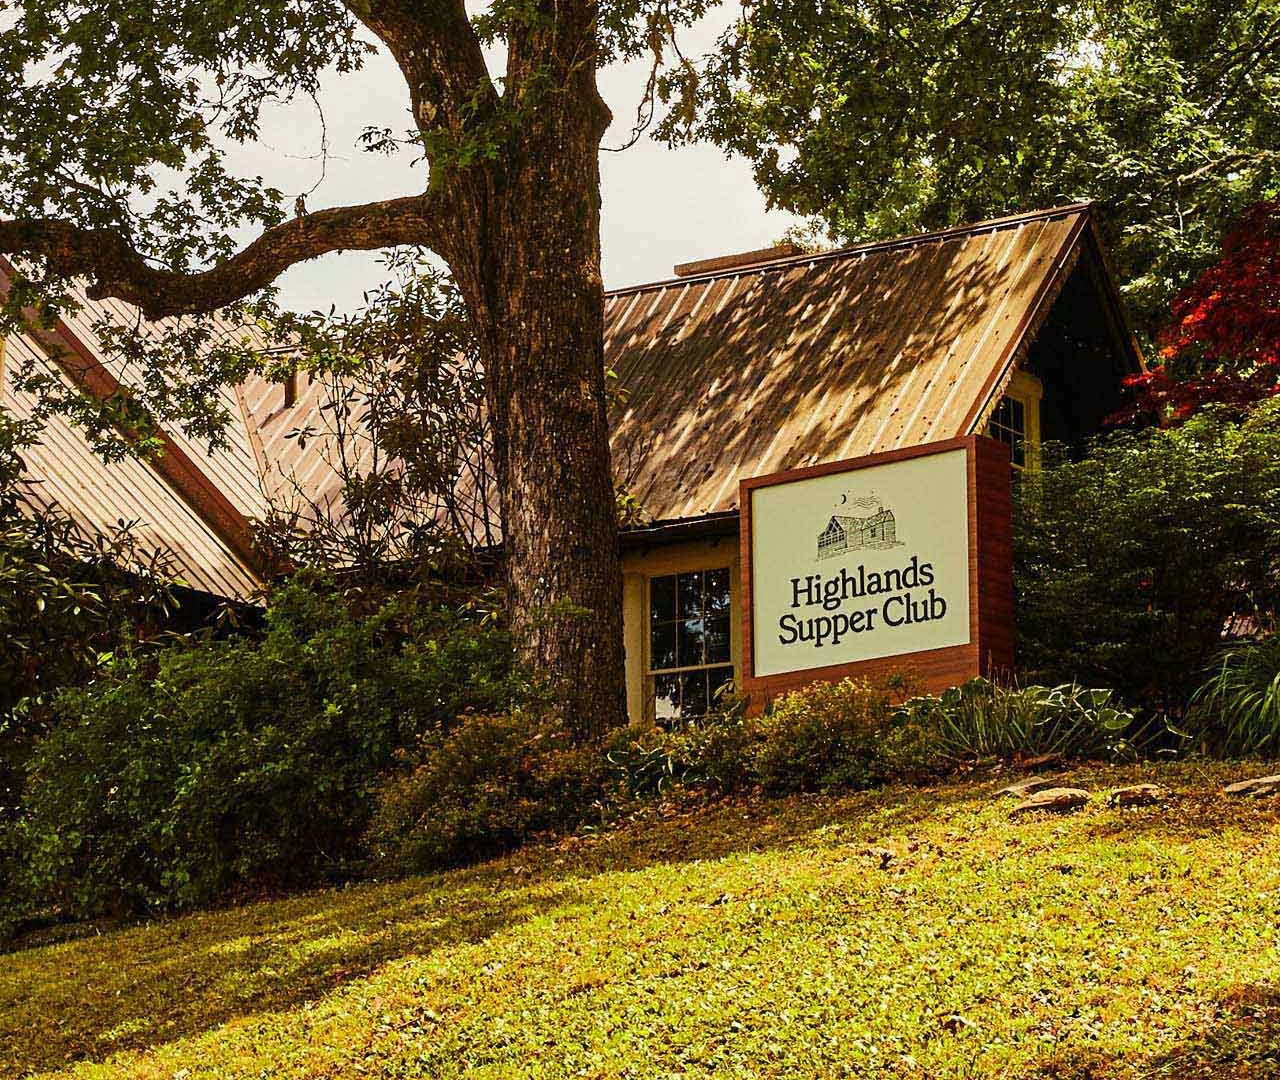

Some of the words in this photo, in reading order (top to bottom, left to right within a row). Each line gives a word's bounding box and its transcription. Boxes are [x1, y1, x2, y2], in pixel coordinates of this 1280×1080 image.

[791, 556, 935, 610] Highlands
[778, 607, 878, 647] Supper
[882, 589, 947, 627] Club
